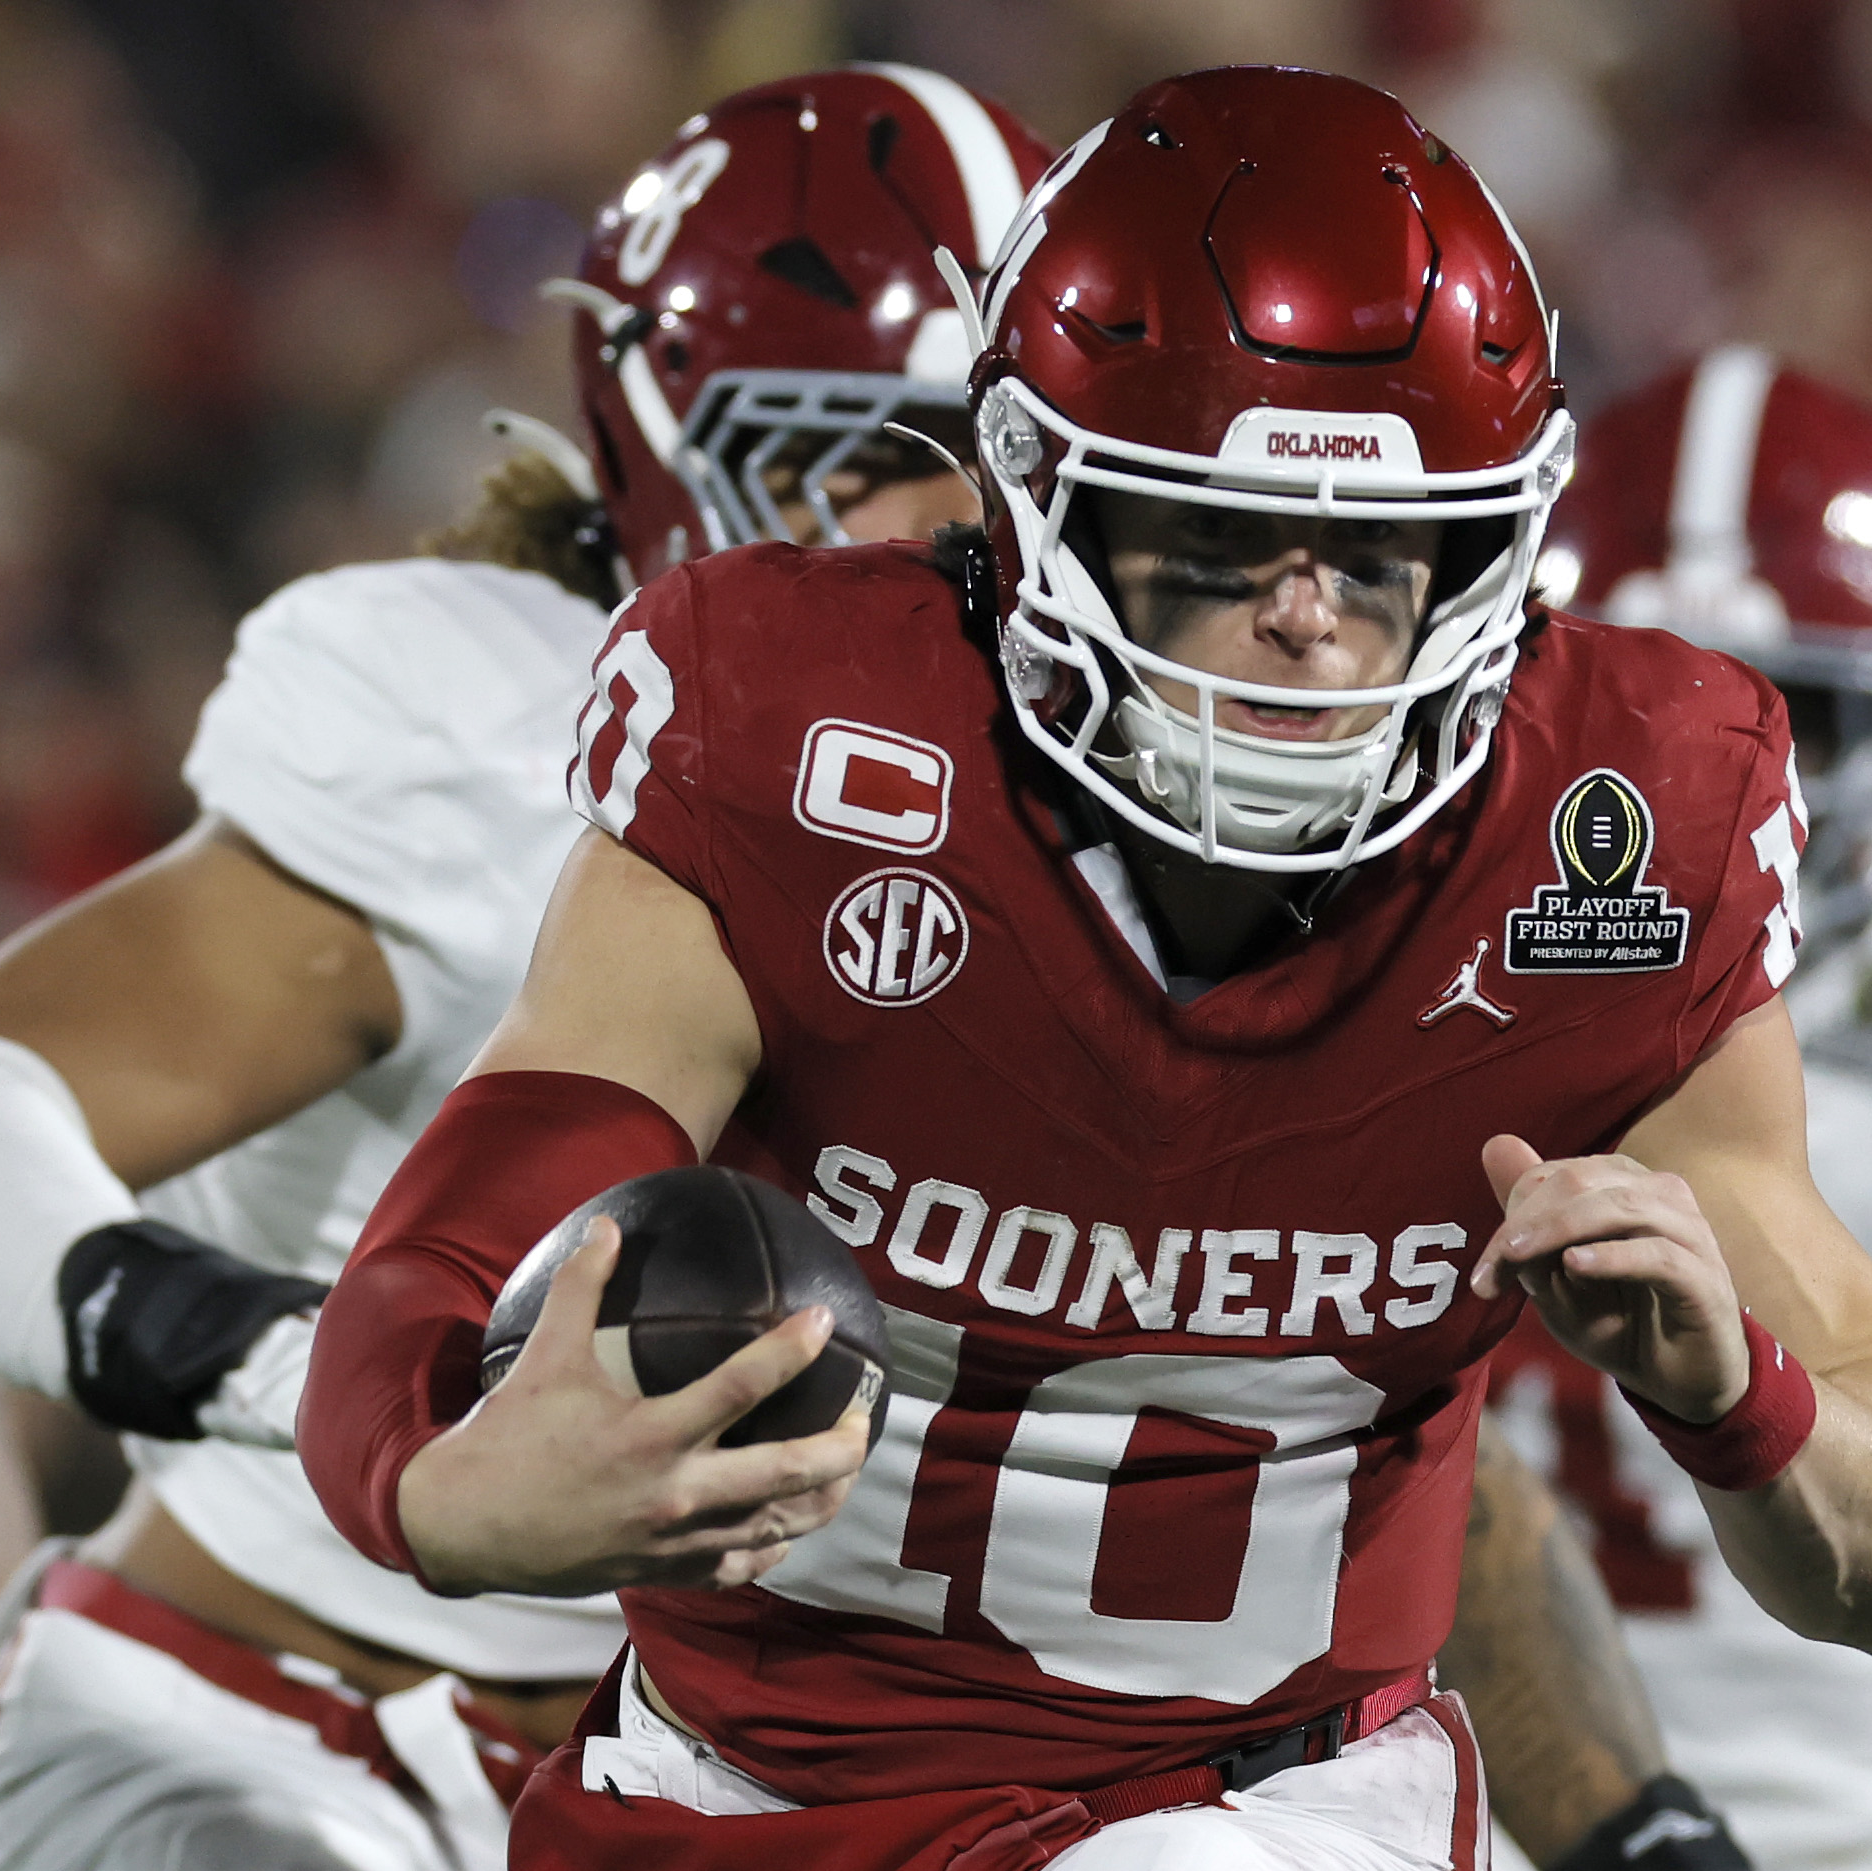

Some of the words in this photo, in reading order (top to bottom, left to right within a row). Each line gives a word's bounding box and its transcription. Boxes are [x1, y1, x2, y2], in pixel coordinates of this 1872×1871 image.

[619, 137, 730, 288] 8
[1267, 431, 1381, 460] OKLAHOMA
[567, 586, 675, 839] 0
[809, 730, 943, 845] C
[837, 880, 956, 996] SEC
[1517, 920, 1592, 940] FIRST
[1597, 920, 1678, 940] ROUND
[1530, 947, 1593, 959] PRESENTED
[1594, 947, 1609, 959] BY
[1610, 946, 1663, 961] Allstate
[1546, 897, 1655, 917] PLAYOFF
[806, 1144, 1469, 1337] SOONERS
[753, 1302, 1387, 1706] 10
